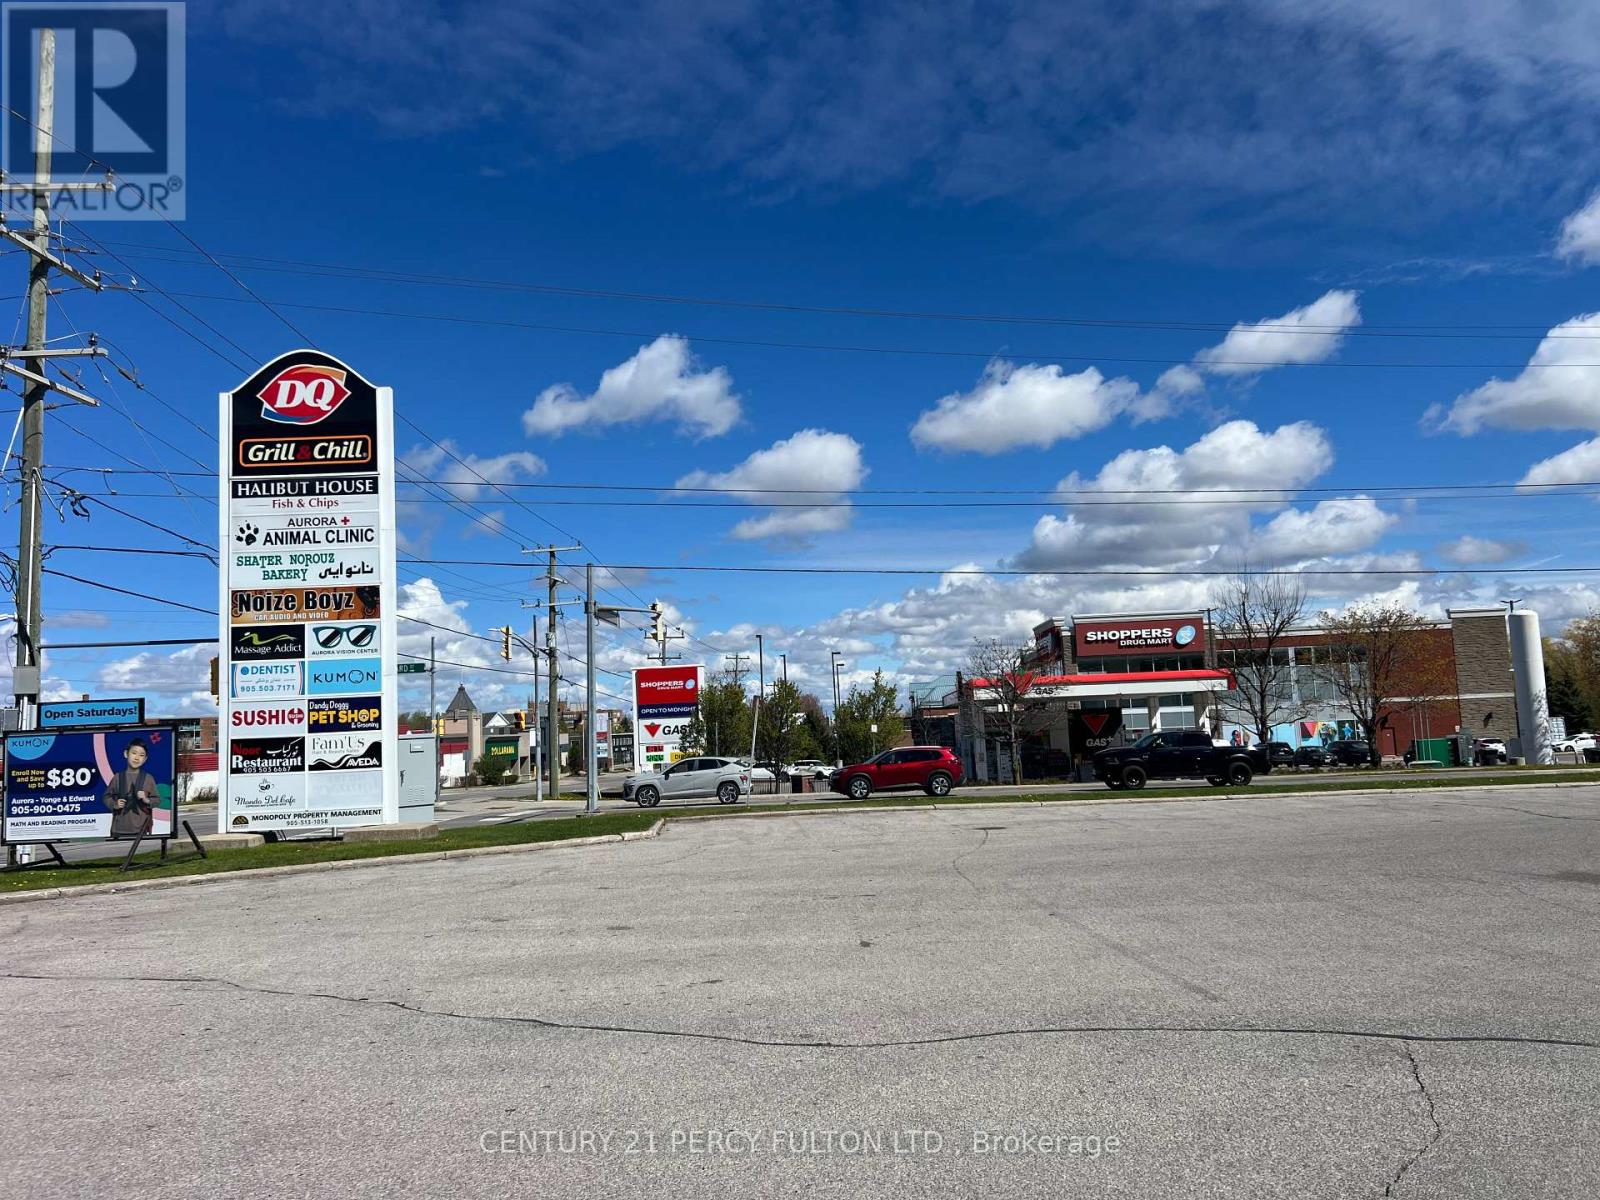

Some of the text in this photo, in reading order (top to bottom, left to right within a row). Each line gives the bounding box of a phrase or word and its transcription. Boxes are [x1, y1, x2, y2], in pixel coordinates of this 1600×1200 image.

[274, 378, 335, 411] DQ
[248, 441, 364, 462] Grill & Chill
[237, 479, 374, 496] HALIBUT HOUSE
[272, 497, 339, 509] Fish & Chips
[287, 516, 338, 527] AURORA
[262, 528, 375, 546] ANIMAL CLINIC
[236, 553, 335, 569] SHATER NOROUZ
[262, 568, 308, 581] BAKERY
[237, 589, 355, 614] Noize Boyz
[308, 611, 329, 619] VIDEO
[1086, 628, 1173, 641] SHOPPERS
[234, 643, 302, 655] Massage Addict
[250, 664, 296, 675] DENTIST
[313, 669, 377, 684] KUMON
[240, 684, 295, 692] 905.503.7171
[640, 680, 684, 688] SHOPPERS
[309, 700, 349, 711] Dandy Doggy
[44, 705, 137, 720] Open Saturdays!
[231, 709, 286, 726] SUSHI
[309, 708, 380, 725] PET SHOP
[357, 721, 379, 729] Grooming
[12, 737, 49, 748] KUMON
[231, 755, 303, 769] Restaurant
[346, 757, 380, 767] AVEDA
[40, 797, 61, 805] Yonge
[11, 803, 81, 814] 905-900-0475
[251, 809, 382, 821] MONOPOLY PROPERTY MANAGEMENT
